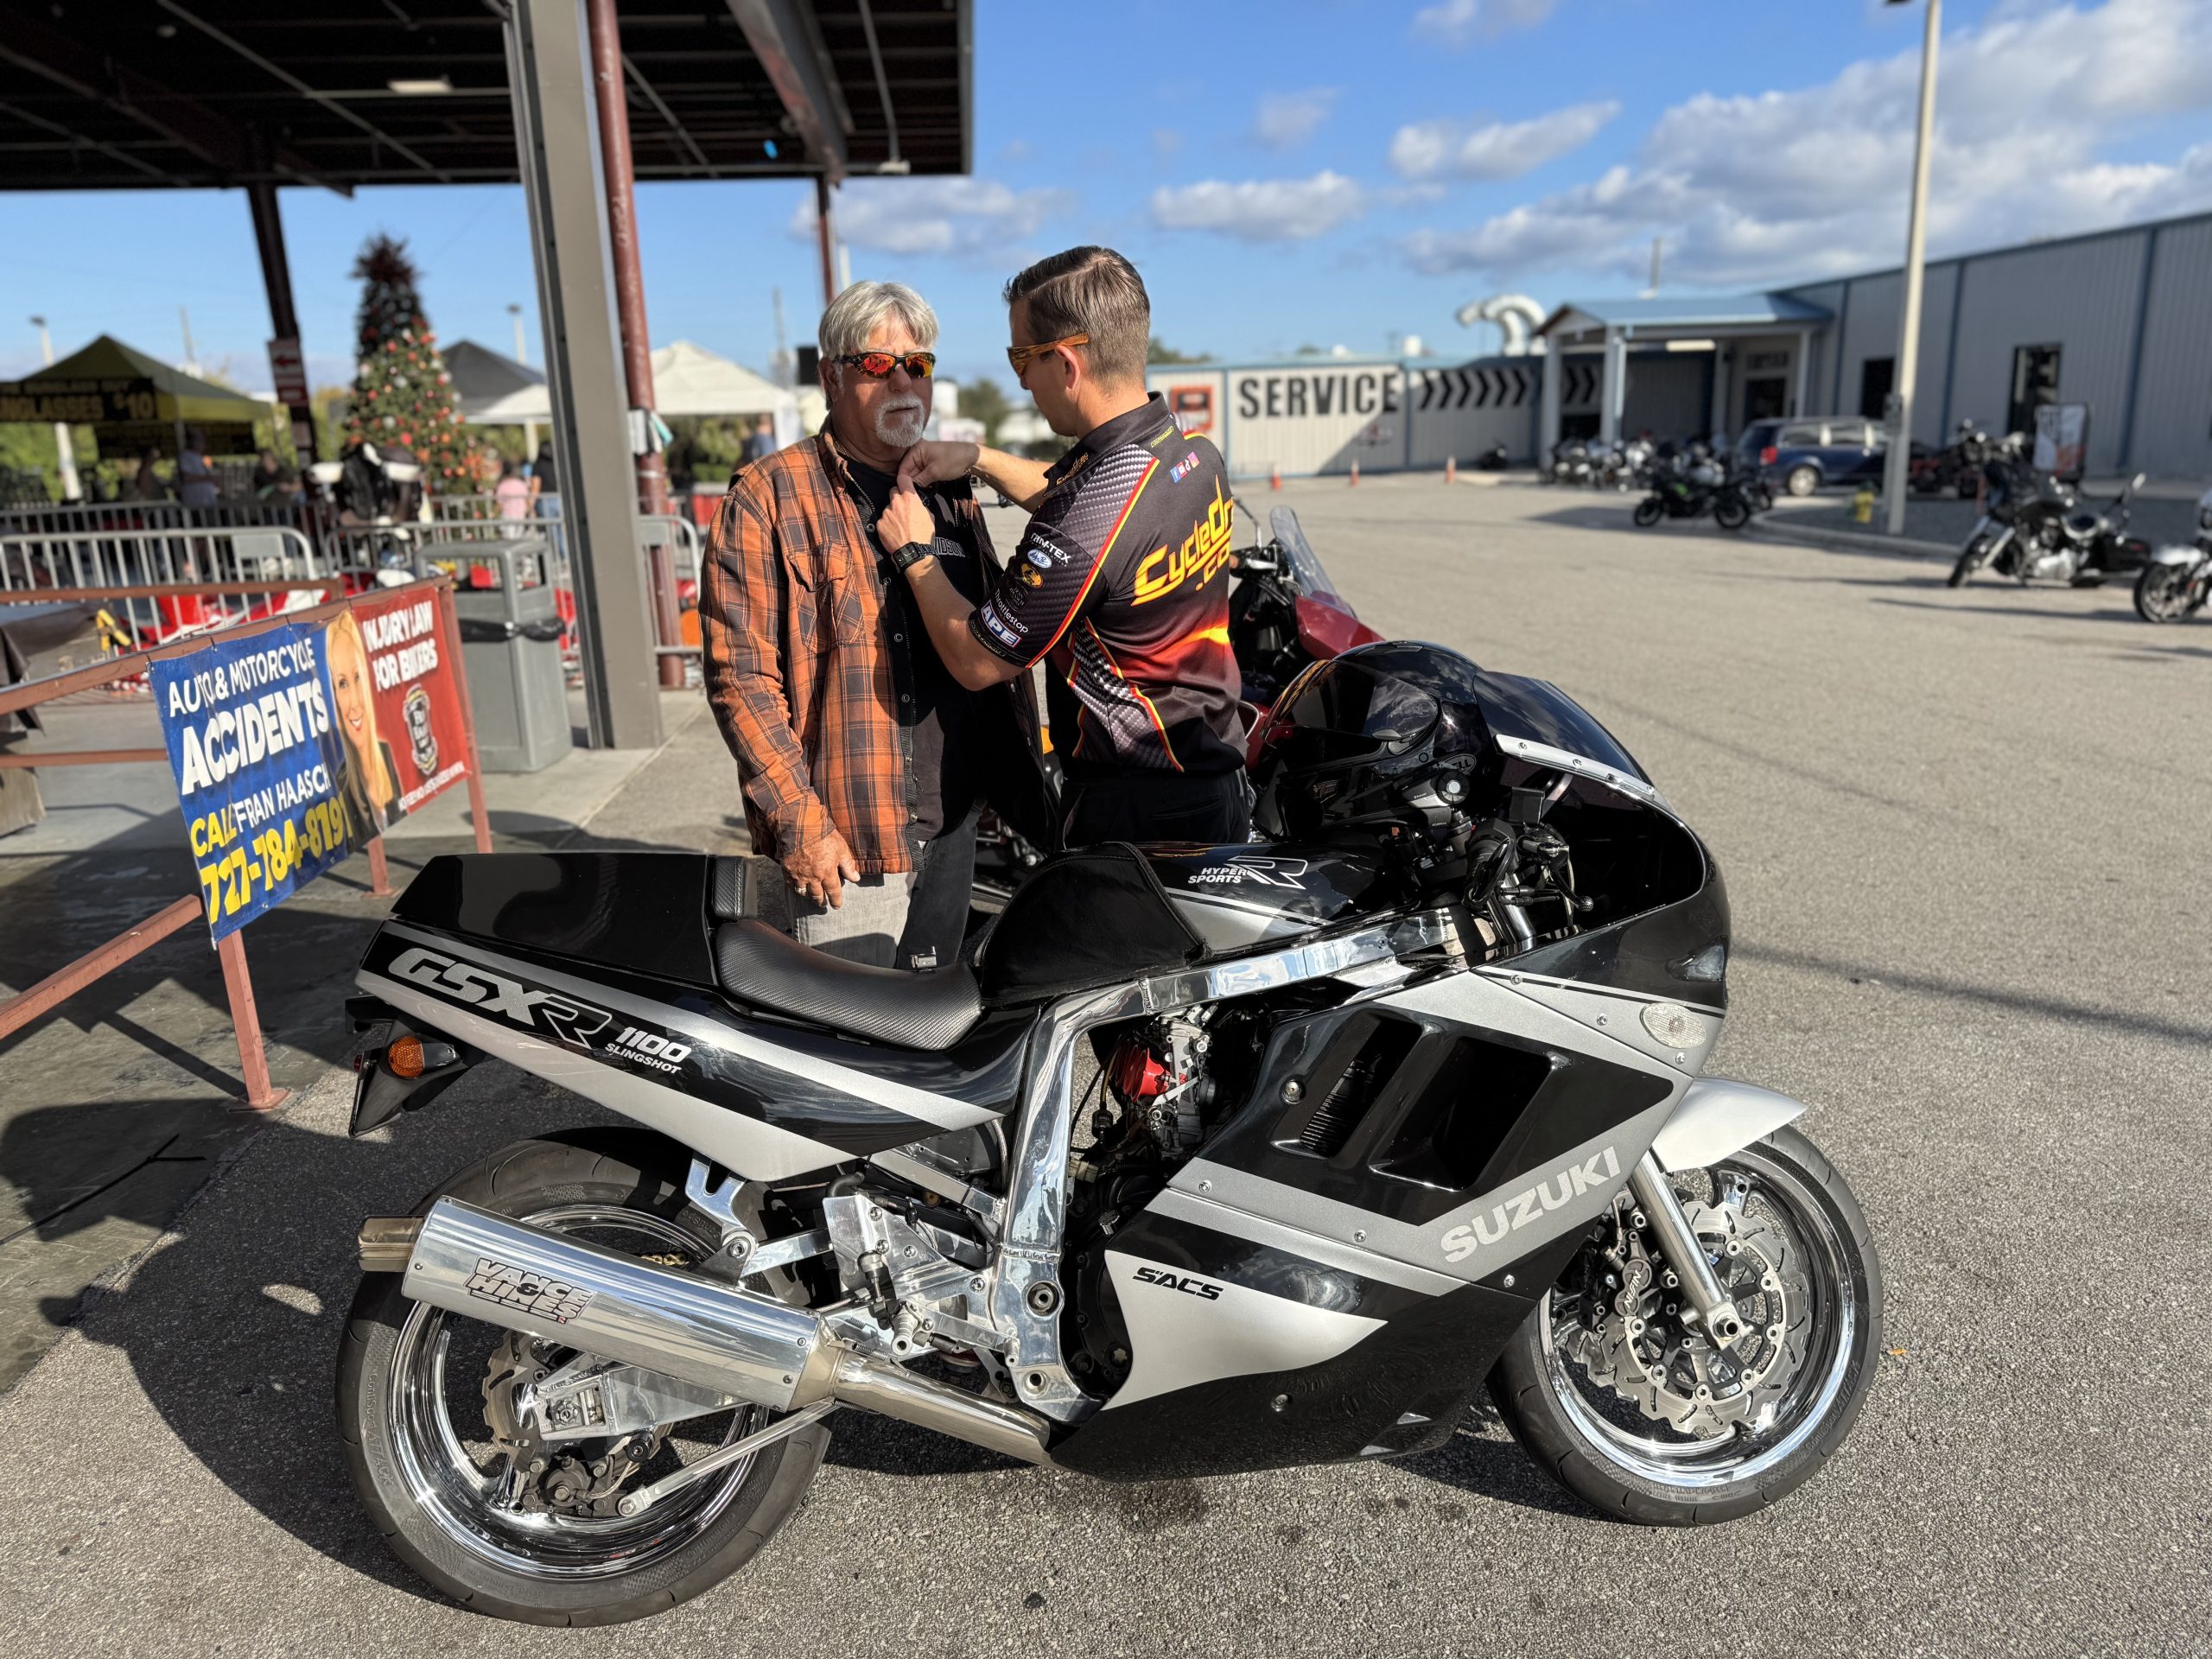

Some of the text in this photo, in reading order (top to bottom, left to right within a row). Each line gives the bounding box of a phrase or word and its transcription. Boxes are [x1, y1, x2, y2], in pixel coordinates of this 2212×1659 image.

[1239, 373, 1398, 418] SERVICE
[982, 605, 1017, 645] APE
[169, 638, 315, 718] AUTO & MOTORCYCLE
[181, 677, 329, 796] ACCIDENTS
[190, 761, 332, 857] CALL FRAN HAASCH
[200, 791, 353, 925] 727-784-8791
[1188, 874, 1243, 884] SPORTS
[1201, 867, 1247, 877] HYPER
[605, 1043, 682, 1075] SLINGSHOT
[617, 1026, 692, 1064] 1100
[1440, 1146, 1621, 1263] SUZUKI
[466, 1274, 582, 1319] HINES
[474, 1257, 594, 1306] VANCE
[1133, 1267, 1224, 1301] SACS
